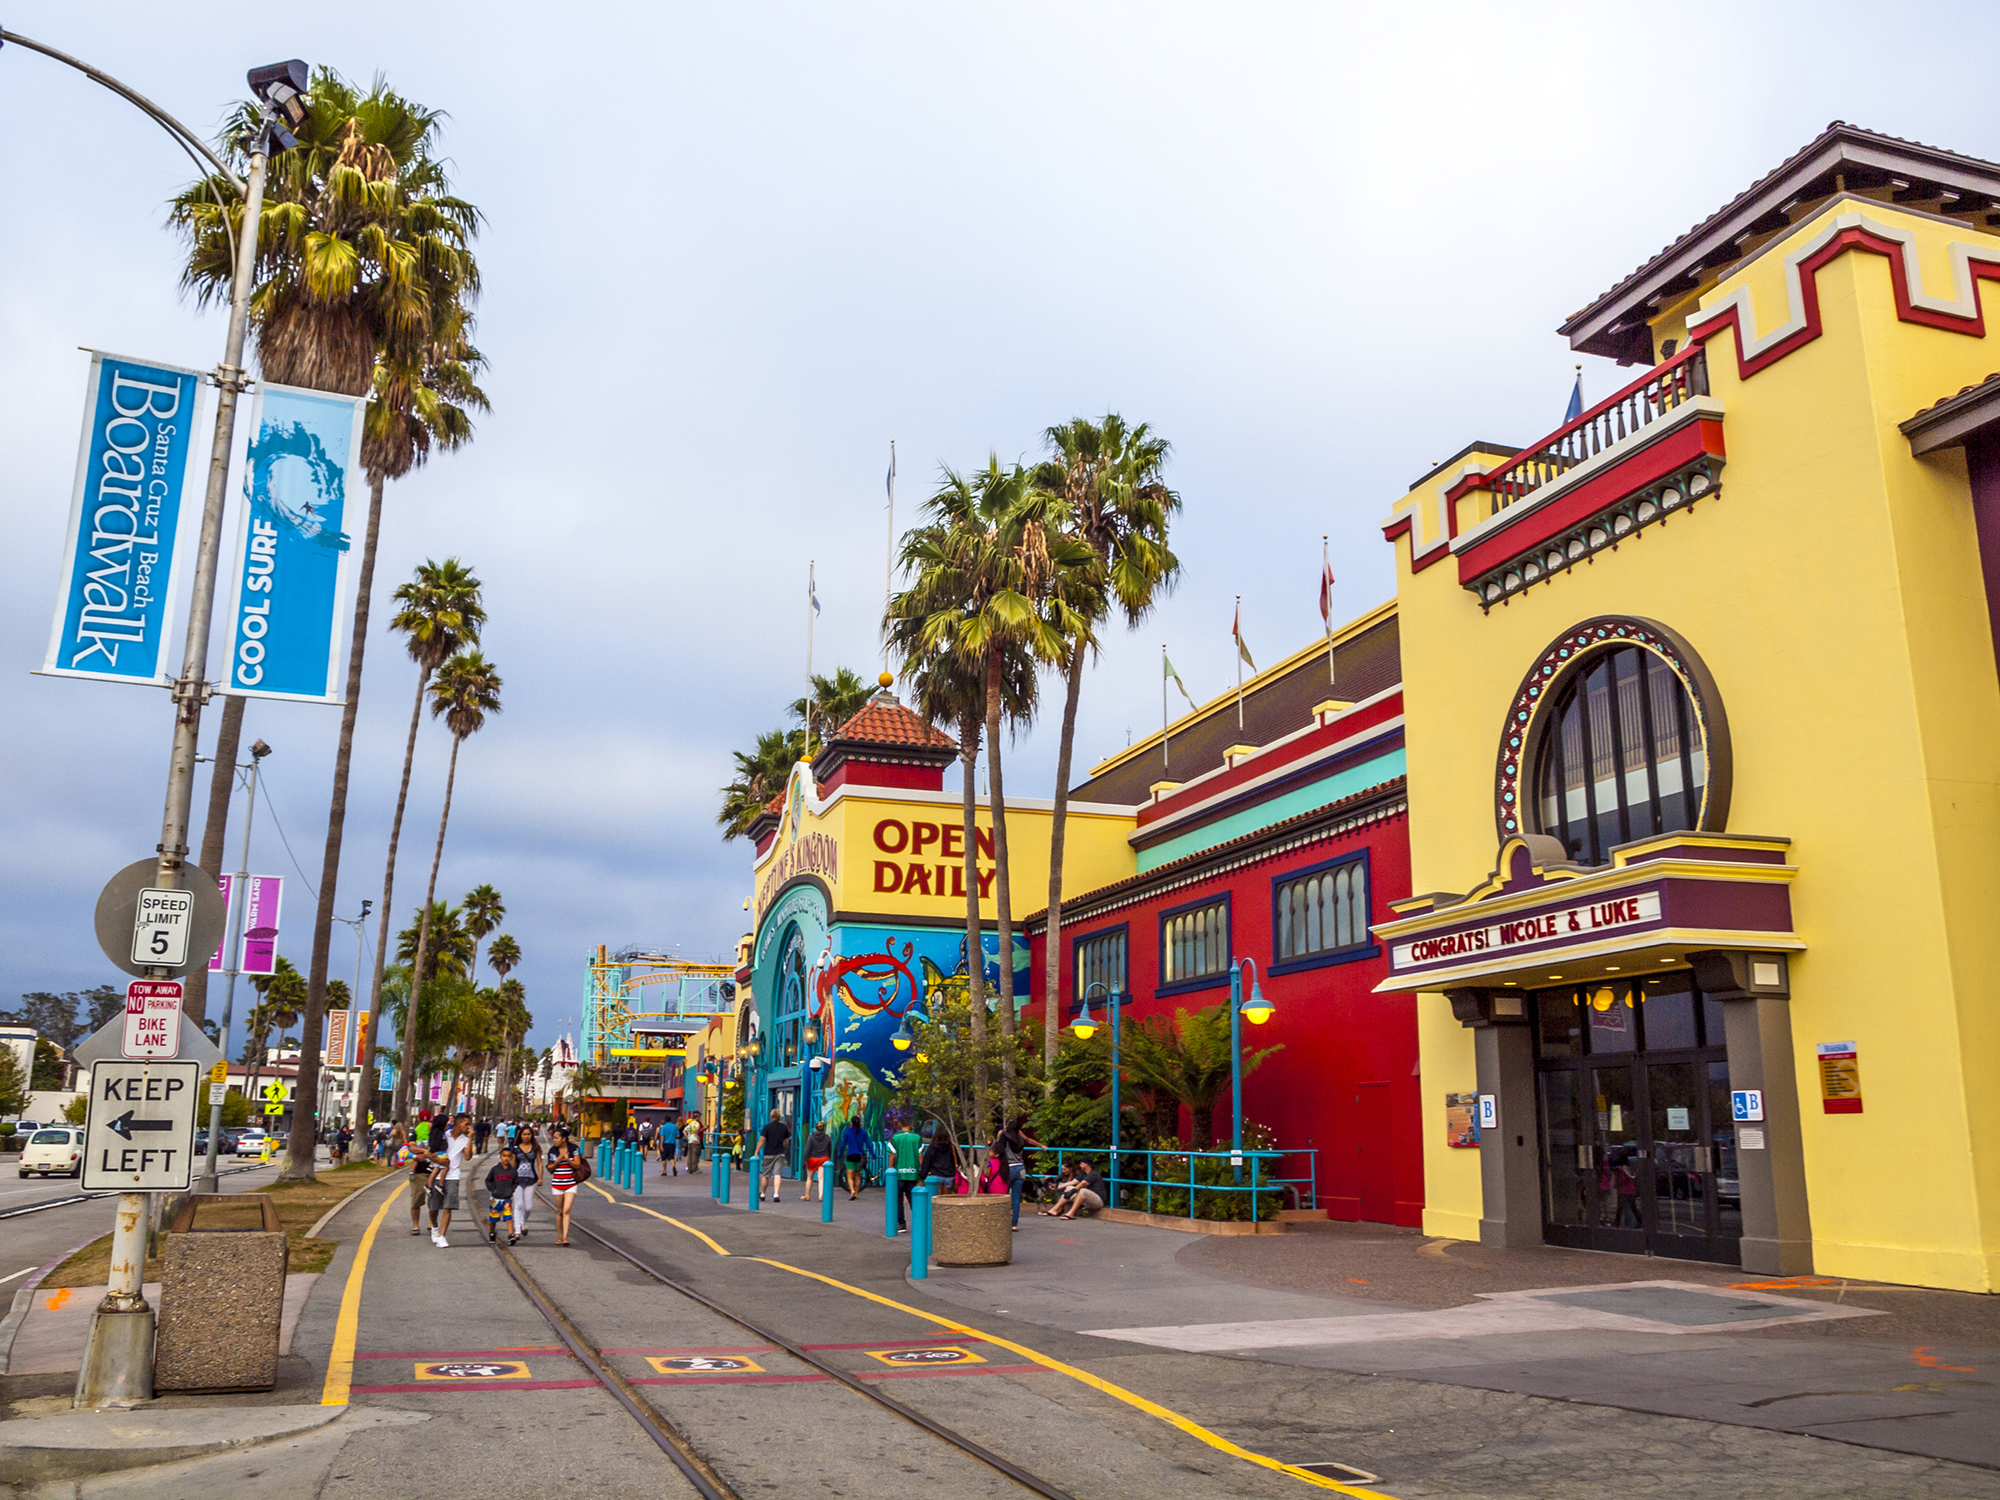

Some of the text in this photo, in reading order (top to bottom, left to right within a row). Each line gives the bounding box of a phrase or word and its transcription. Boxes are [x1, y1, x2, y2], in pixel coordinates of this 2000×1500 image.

[72, 369, 182, 668] Boardwalk
[133, 423, 177, 609] Santa Cruz Beach
[237, 518, 278, 686] COOL SURF
[872, 818, 996, 861] OPEN
[796, 831, 838, 884] KINGDOM
[872, 860, 997, 899] DAILY
[143, 898, 188, 911] SPEED
[249, 878, 262, 930] WARM SAND
[146, 912, 182, 925] LIMIT
[1411, 898, 1640, 961] CONGRATS! NICOLE & LUKE
[150, 930, 169, 955] 5
[133, 984, 178, 995] TOW AWAY
[128, 996, 177, 1011] NO PARKING
[138, 1017, 167, 1031] BIKE
[135, 1033, 167, 1046] LANE
[104, 1078, 184, 1101] KEEP
[1483, 1101, 1493, 1118] B
[102, 1149, 177, 1172] LEFT
